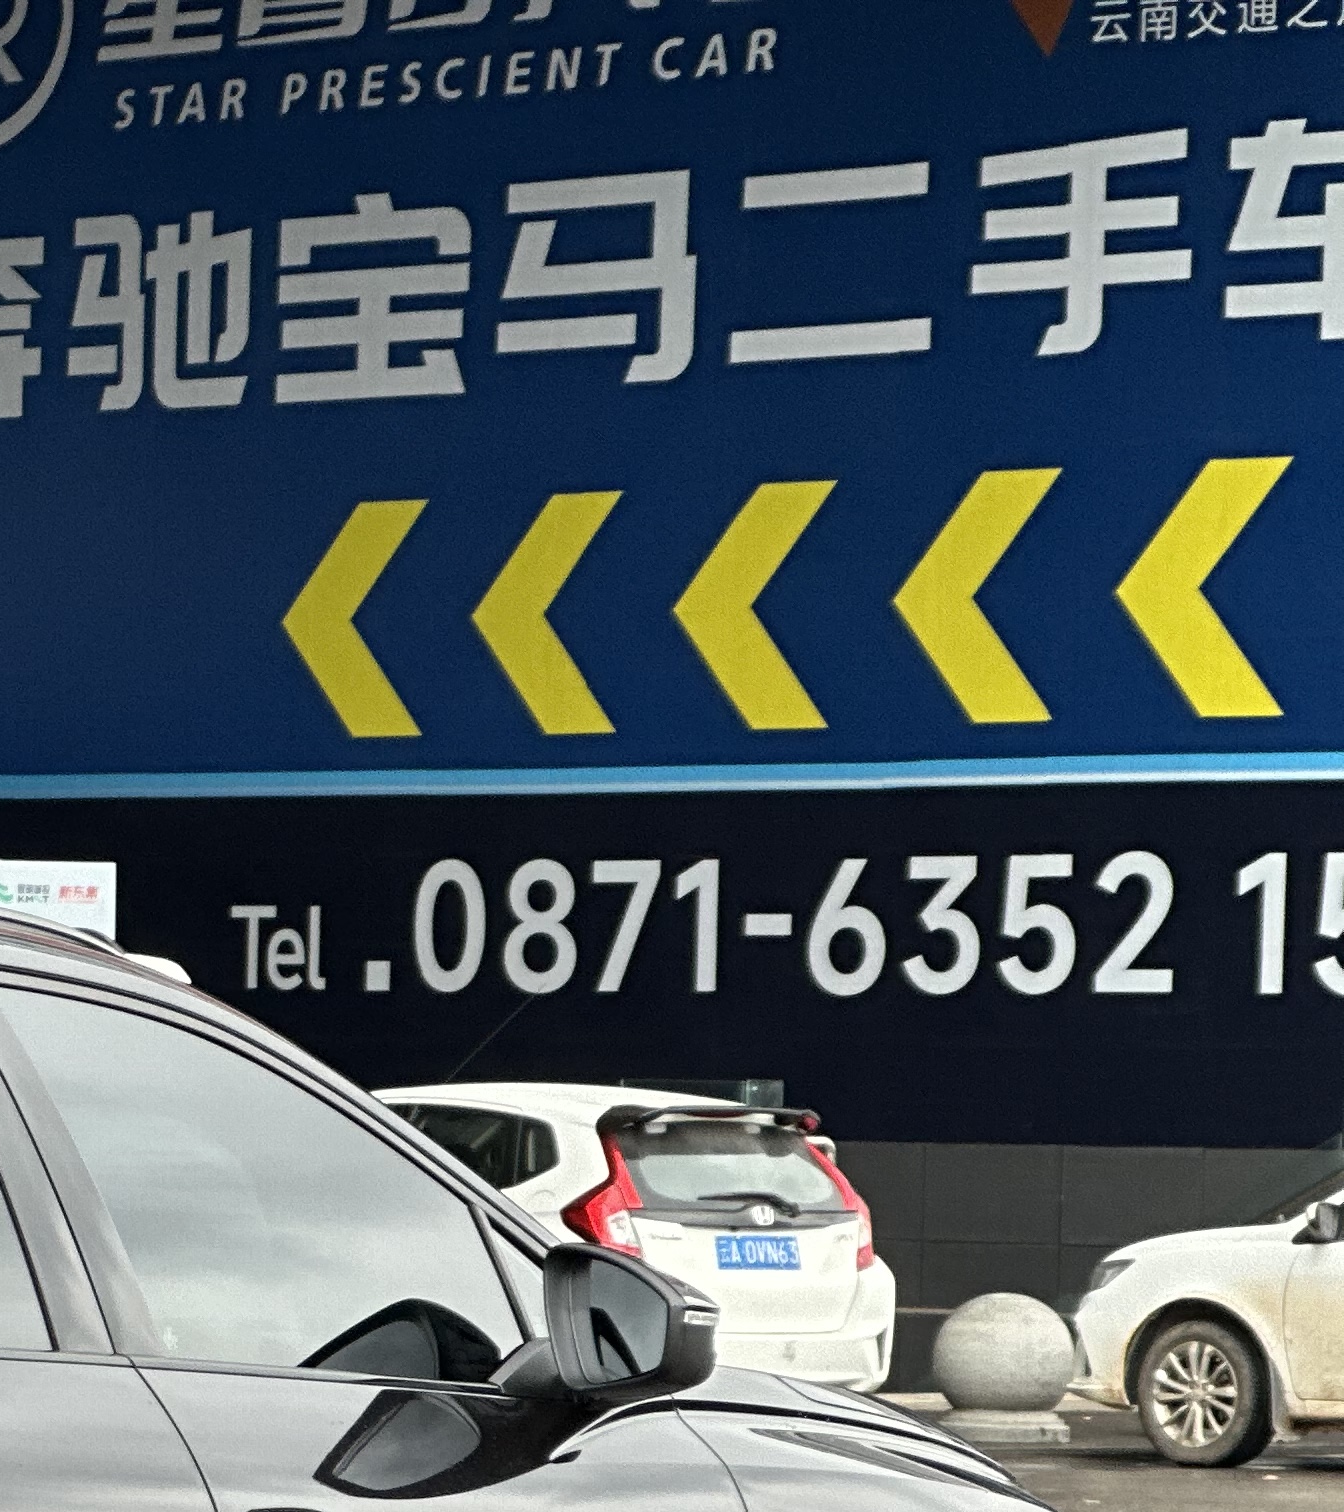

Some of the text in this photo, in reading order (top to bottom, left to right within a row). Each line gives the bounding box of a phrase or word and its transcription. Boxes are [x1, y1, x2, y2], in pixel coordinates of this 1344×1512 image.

[1090, 0, 1344, 43] 云南交通之
[114, 77, 248, 130] STAR
[279, 42, 622, 116] PRESCIENT
[651, 27, 779, 81] CAR
[230, 904, 326, 991] Tel
